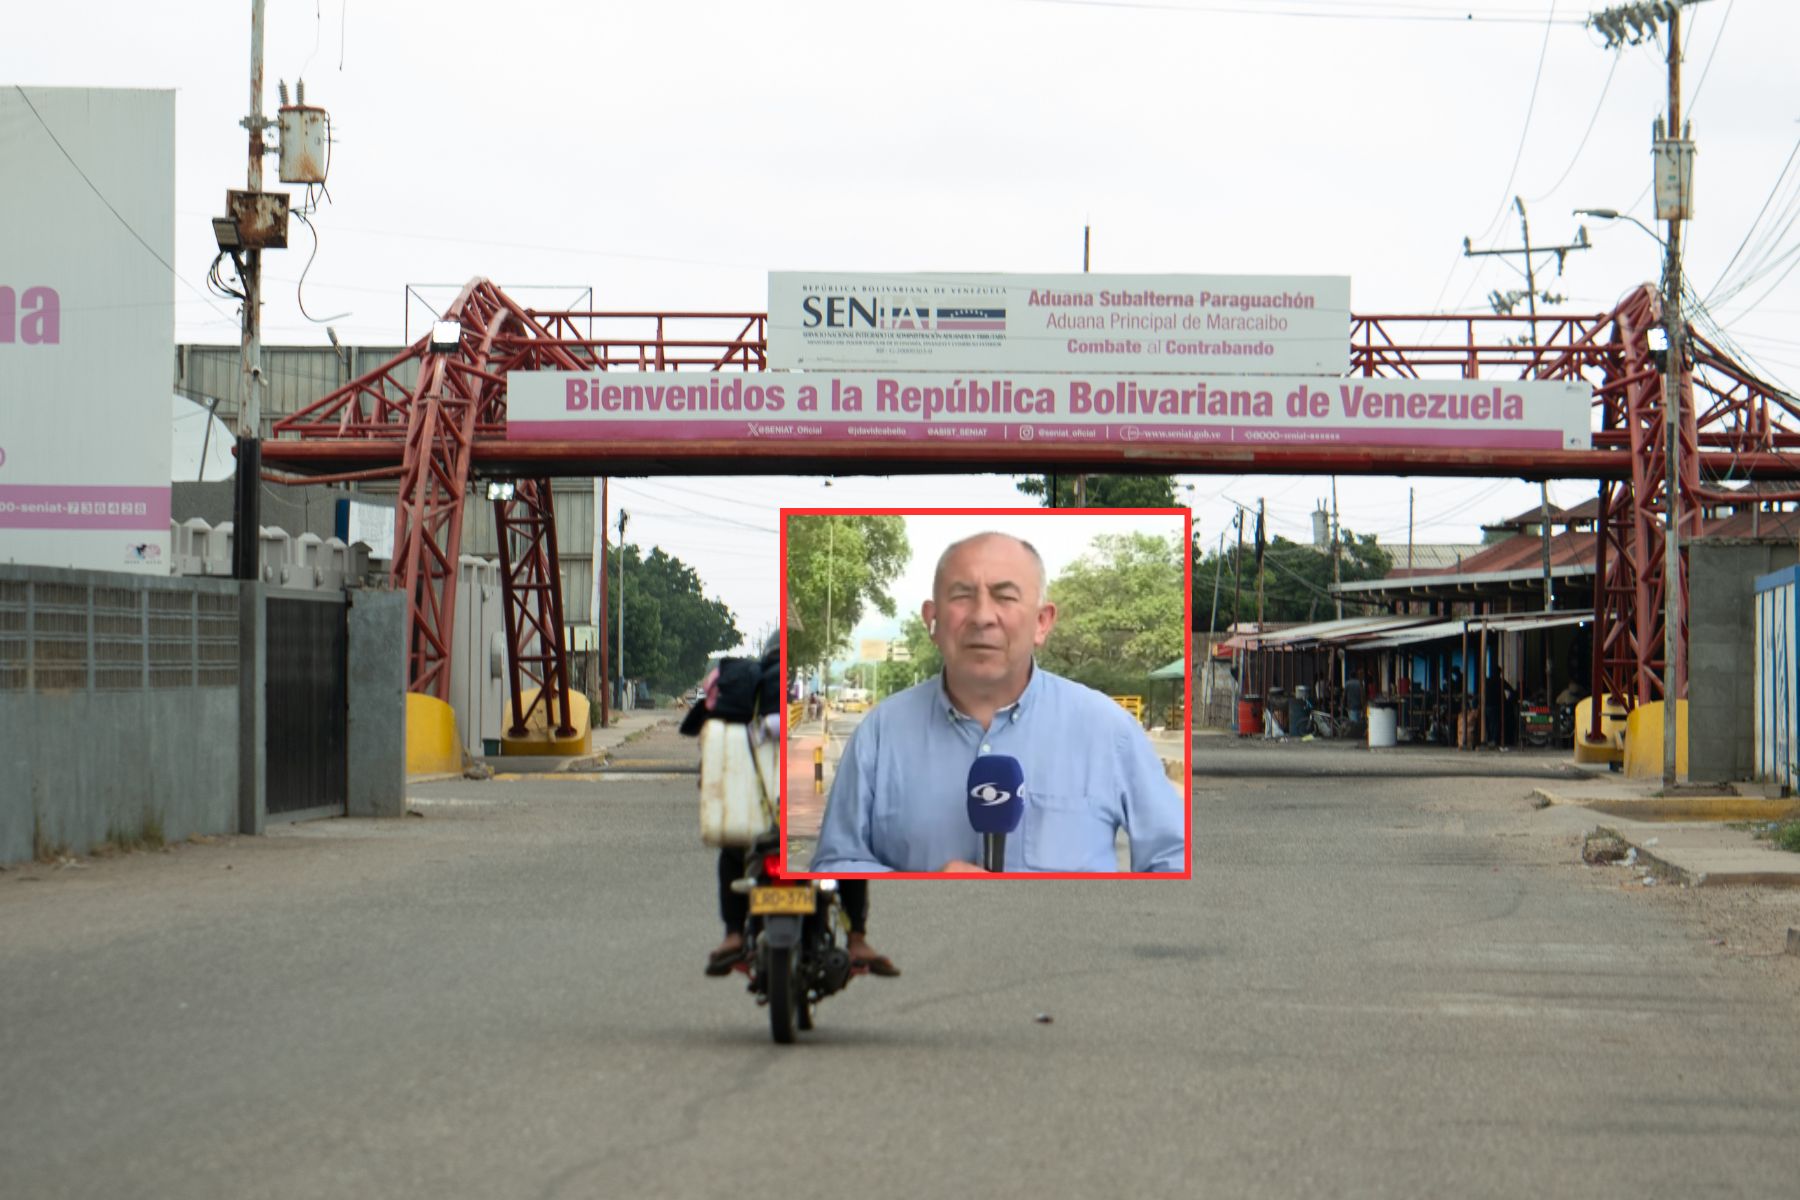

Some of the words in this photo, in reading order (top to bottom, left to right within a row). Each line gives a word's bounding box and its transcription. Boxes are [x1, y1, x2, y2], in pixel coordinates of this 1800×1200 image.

[1028, 289, 1093, 307] Aduana
[1099, 290, 1194, 309] Subalterna
[1199, 291, 1315, 312] Paraguachón
[803, 295, 938, 331] SENIAT
[1046, 312, 1105, 330] Aduana
[1110, 312, 1177, 333] Principal
[1182, 313, 1201, 331] de
[1206, 313, 1288, 331] Maracaibo
[1067, 338, 1142, 355] Combate
[1147, 339, 1161, 355] al
[1165, 339, 1274, 356] Contrabando
[566, 378, 785, 412] Bienvenidos
[797, 385, 818, 412] a
[831, 378, 863, 412] la
[876, 378, 1055, 420] República
[1069, 381, 1273, 417] Bolivariana
[1286, 384, 1330, 418] de
[1340, 385, 1523, 421] Venezuela
